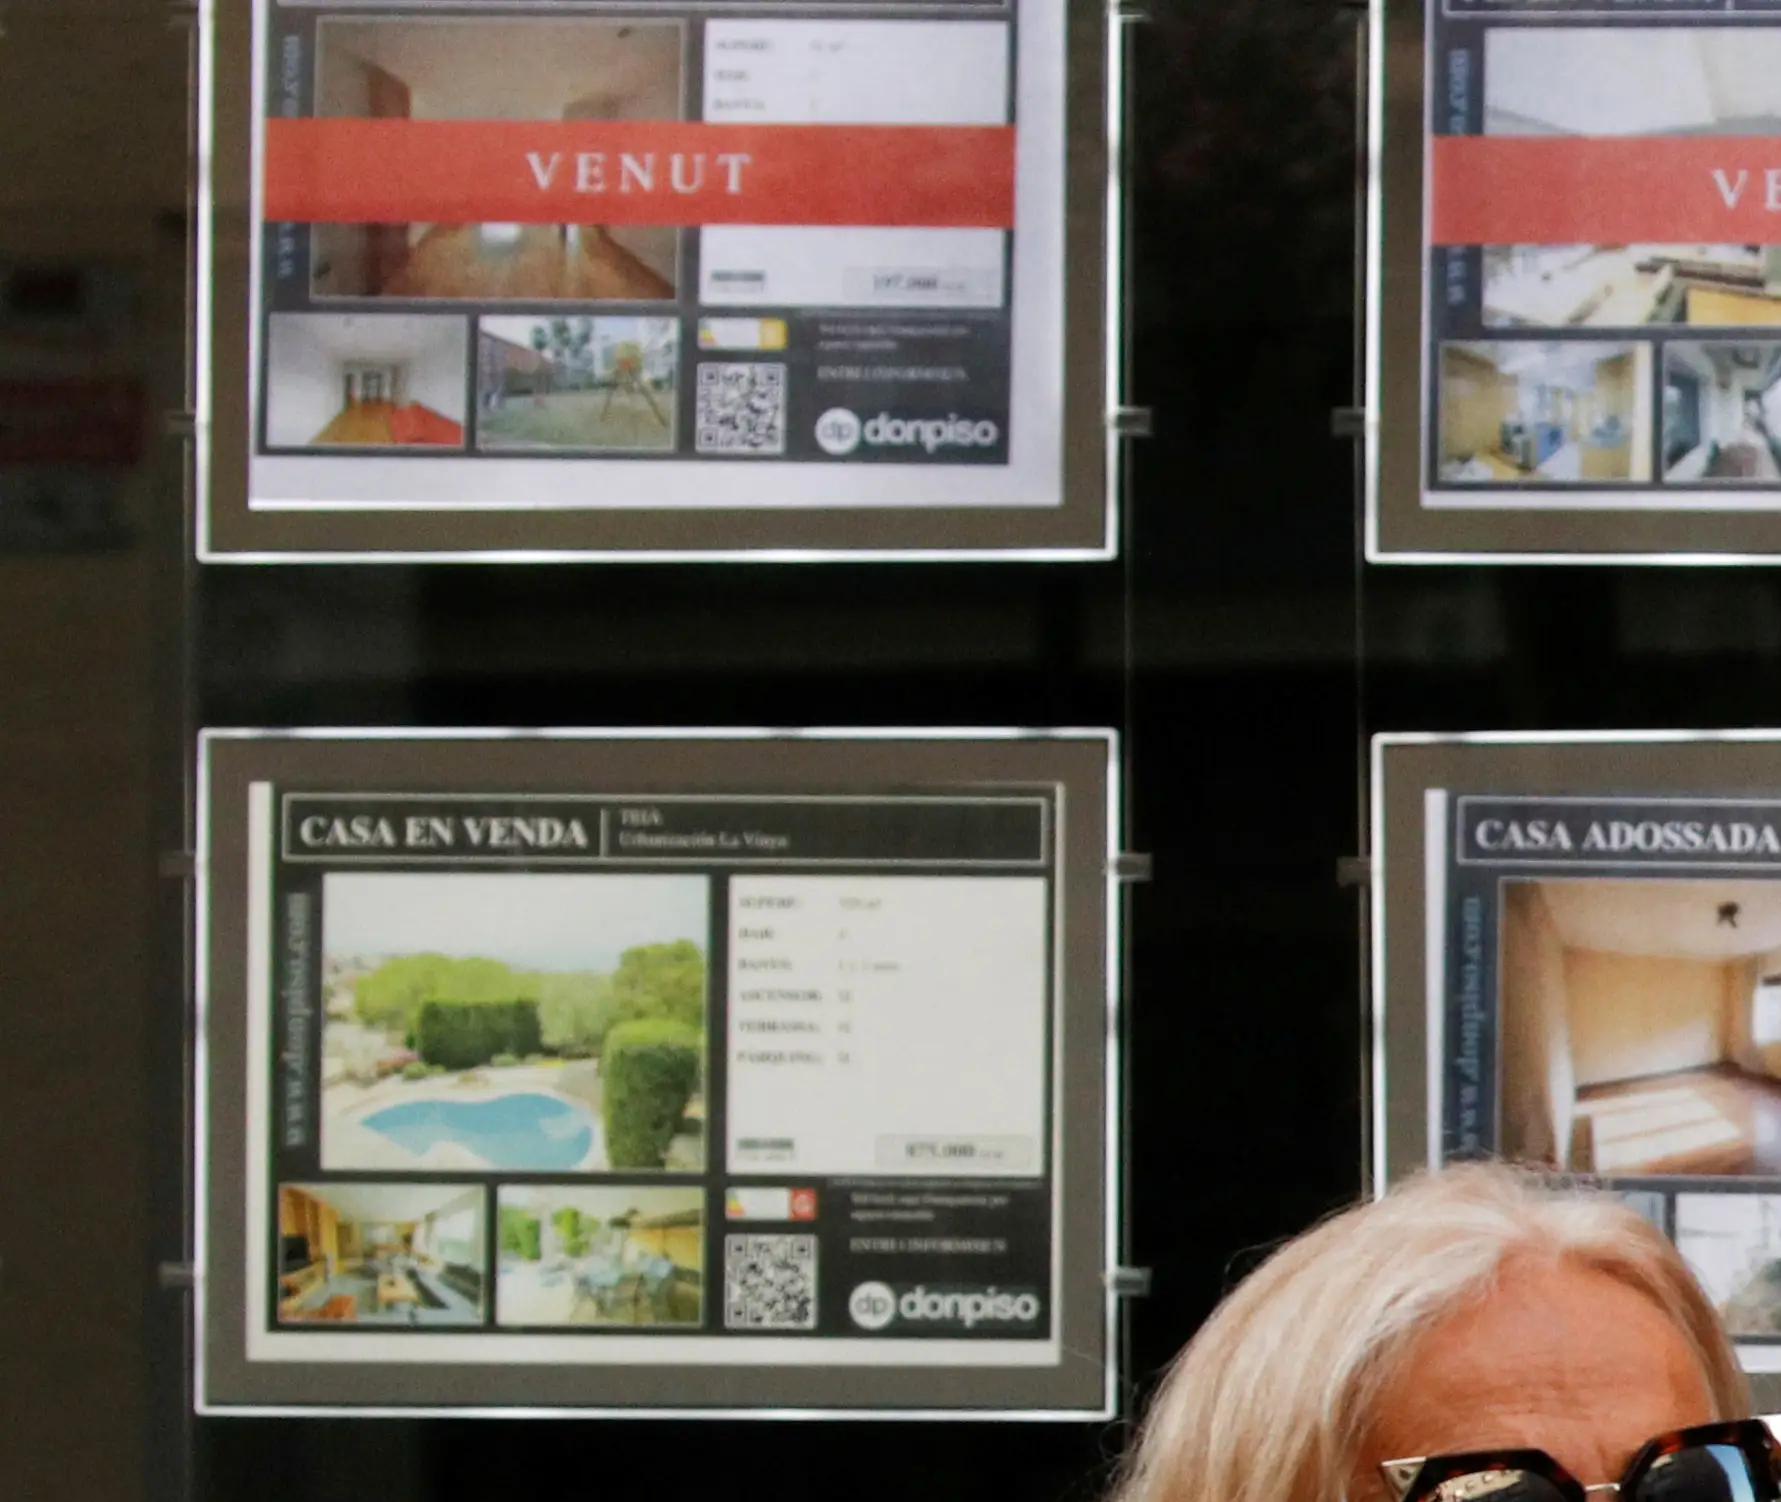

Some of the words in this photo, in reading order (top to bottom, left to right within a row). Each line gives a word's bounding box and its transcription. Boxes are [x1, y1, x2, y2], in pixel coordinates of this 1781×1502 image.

[525, 151, 752, 194] VENUT
[859, 412, 998, 453] donpiso
[300, 817, 396, 846] CASA
[405, 816, 454, 847] EN
[463, 817, 588, 848] VENDA
[1476, 822, 1572, 852] CASA
[1584, 821, 1781, 854] ADOSSADA
[895, 1285, 1039, 1328] donpiso
